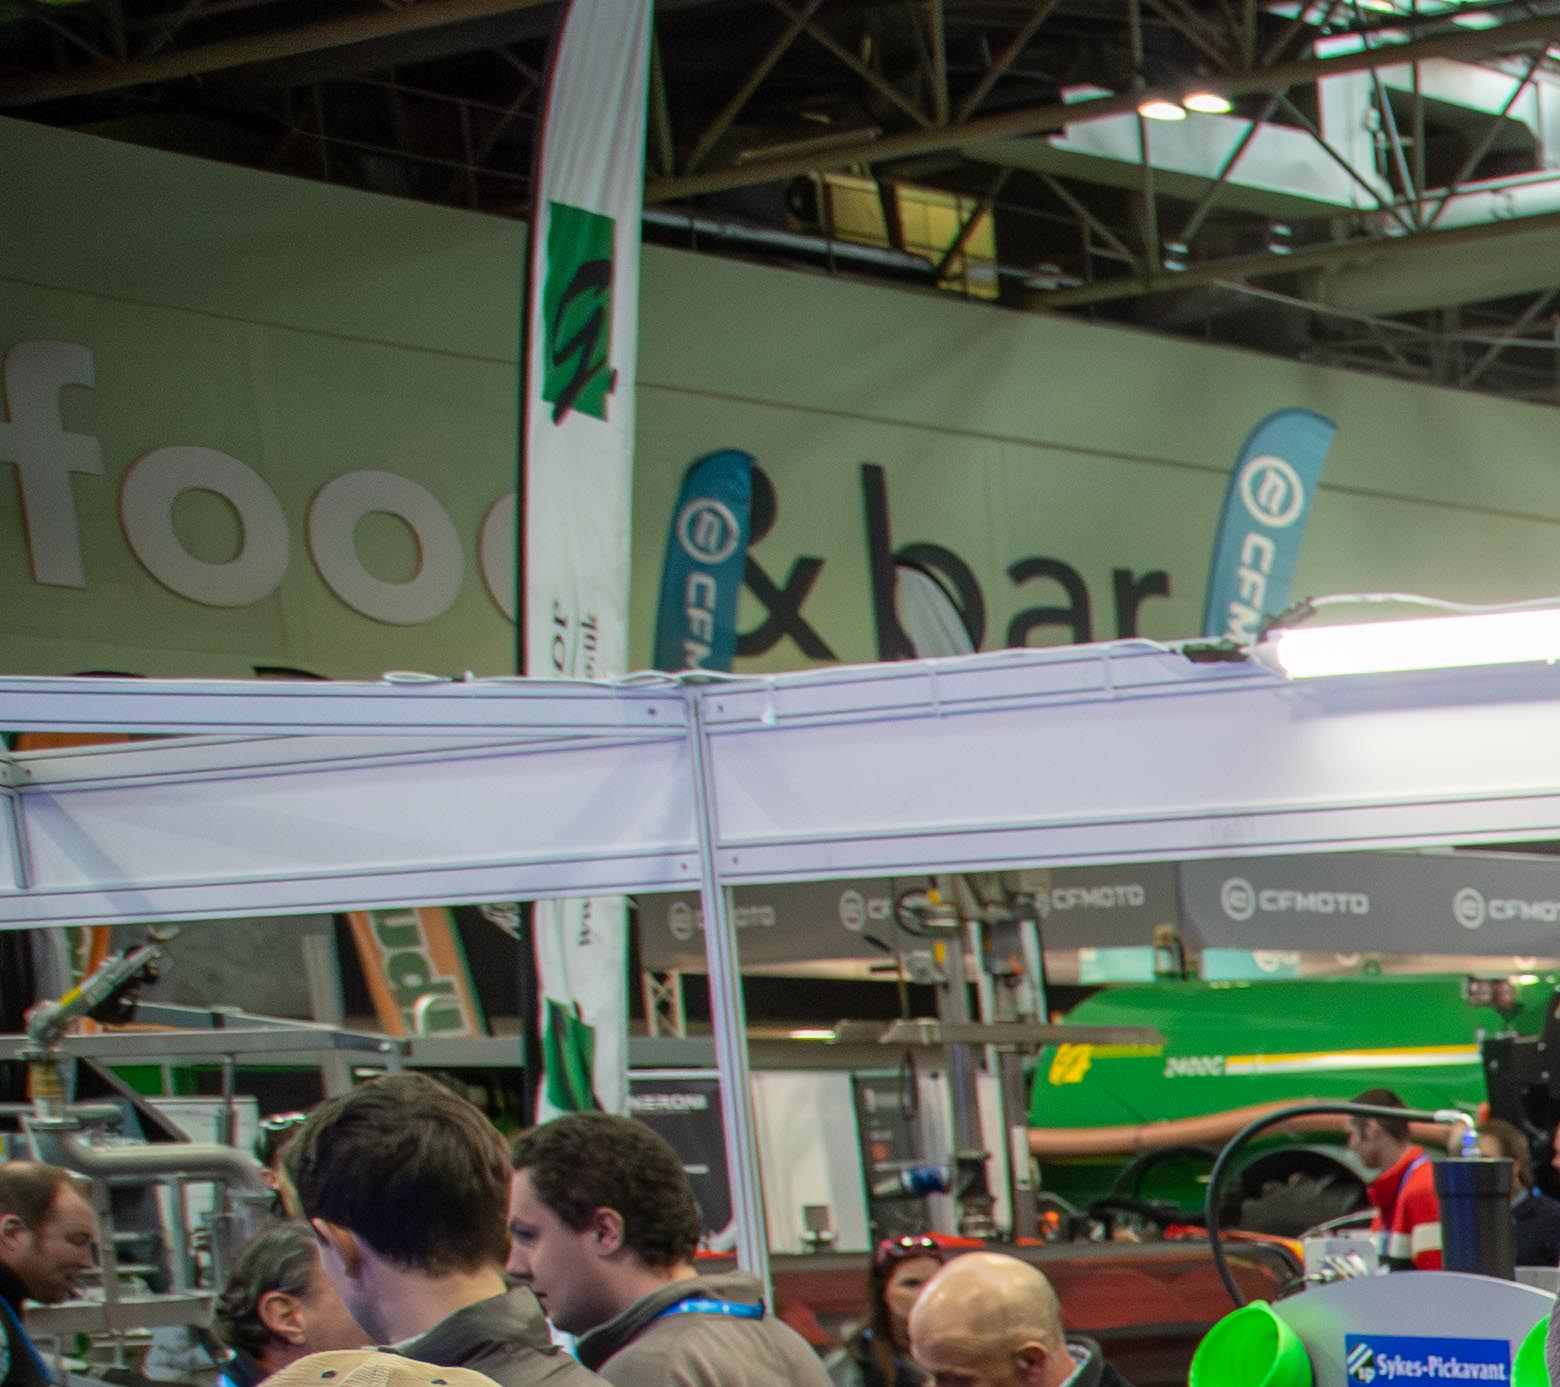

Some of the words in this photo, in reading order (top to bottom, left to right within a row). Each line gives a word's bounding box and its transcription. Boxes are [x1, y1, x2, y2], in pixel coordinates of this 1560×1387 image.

[860, 462, 1172, 663] bar
[1258, 889, 1370, 917] CFMOTO
[1377, 1353, 1506, 1381] Sykes-Pickavant
